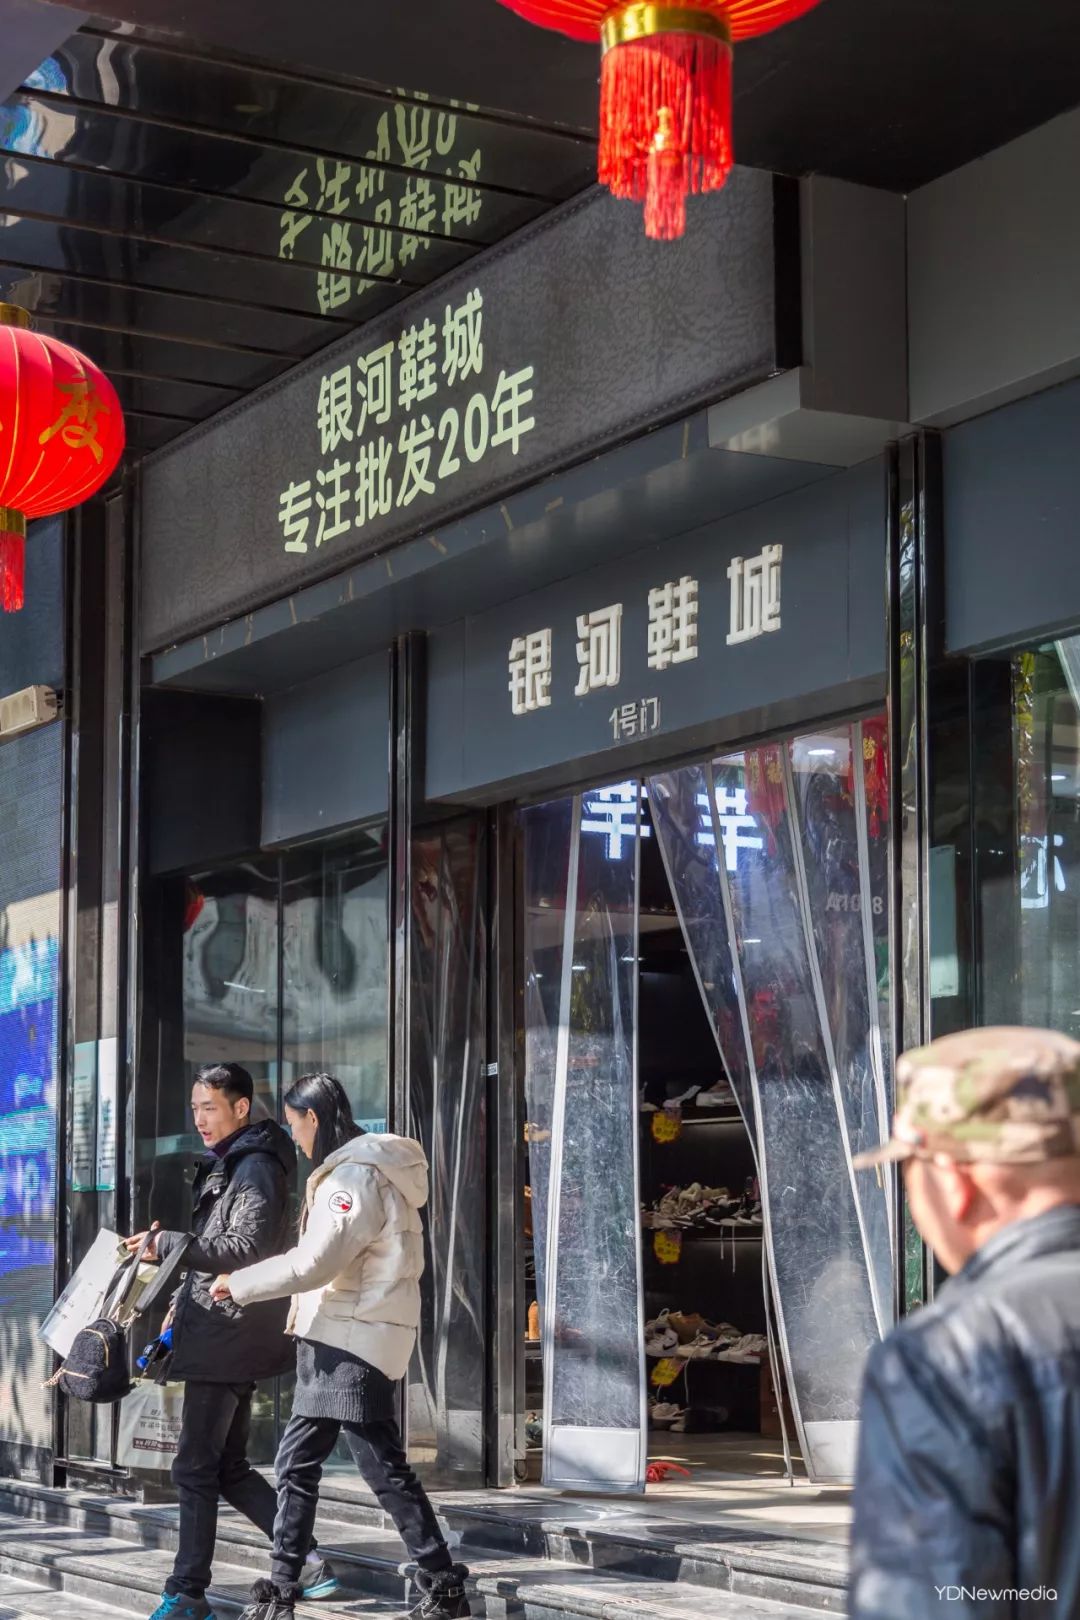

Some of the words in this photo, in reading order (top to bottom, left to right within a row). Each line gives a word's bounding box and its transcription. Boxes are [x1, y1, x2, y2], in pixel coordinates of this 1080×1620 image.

[317, 288, 483, 455] 银河鞋城
[278, 366, 535, 553] 专注批发20年
[508, 543, 782, 715] 银河鞋城
[609, 696, 660, 740] 1号门
